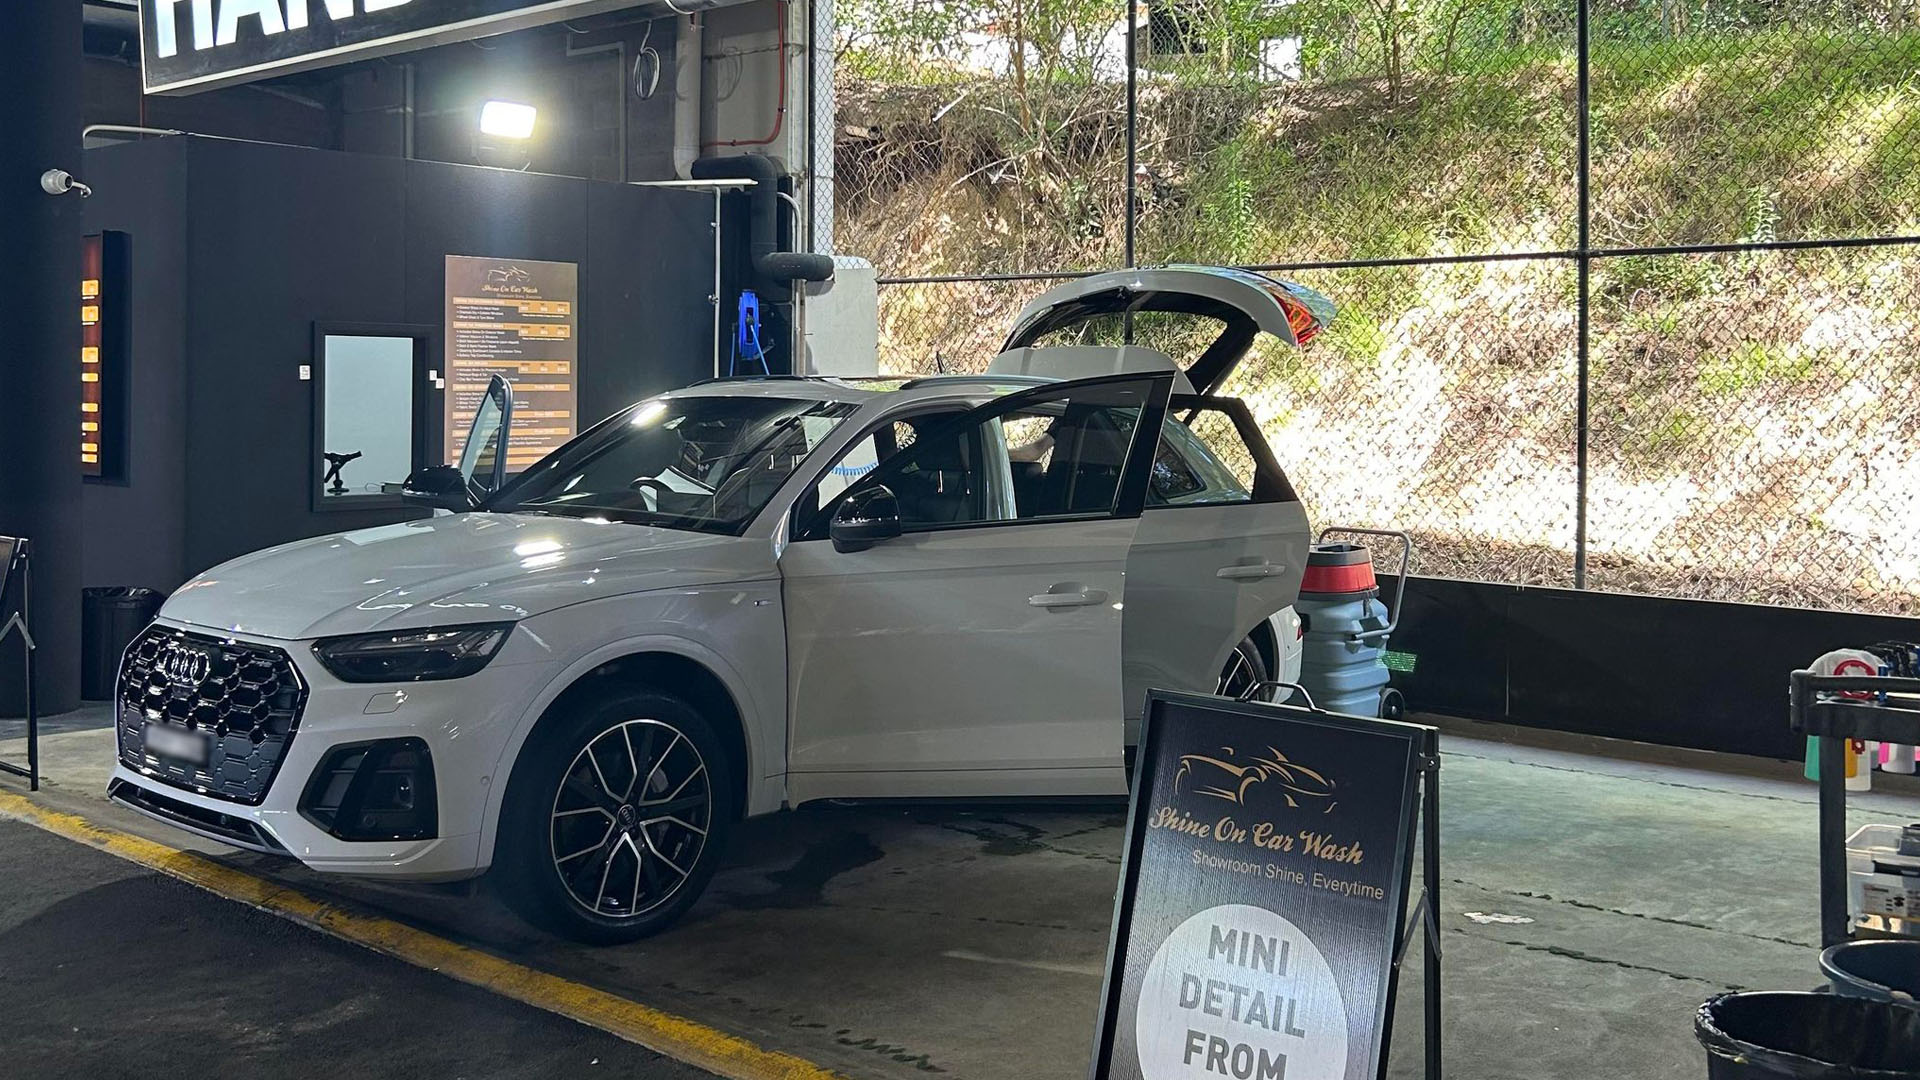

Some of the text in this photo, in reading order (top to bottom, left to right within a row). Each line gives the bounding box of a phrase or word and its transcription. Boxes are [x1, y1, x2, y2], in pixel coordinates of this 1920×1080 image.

[155, 0, 416, 58] HAN
[1149, 806, 1364, 865] Shine On Car Wash
[1192, 849, 1261, 877] Showroom
[1313, 872, 1384, 900] Everytime
[1207, 924, 1290, 977] MINI
[1179, 972, 1305, 1038] DETAIL
[1183, 1028, 1288, 1080] FROM
